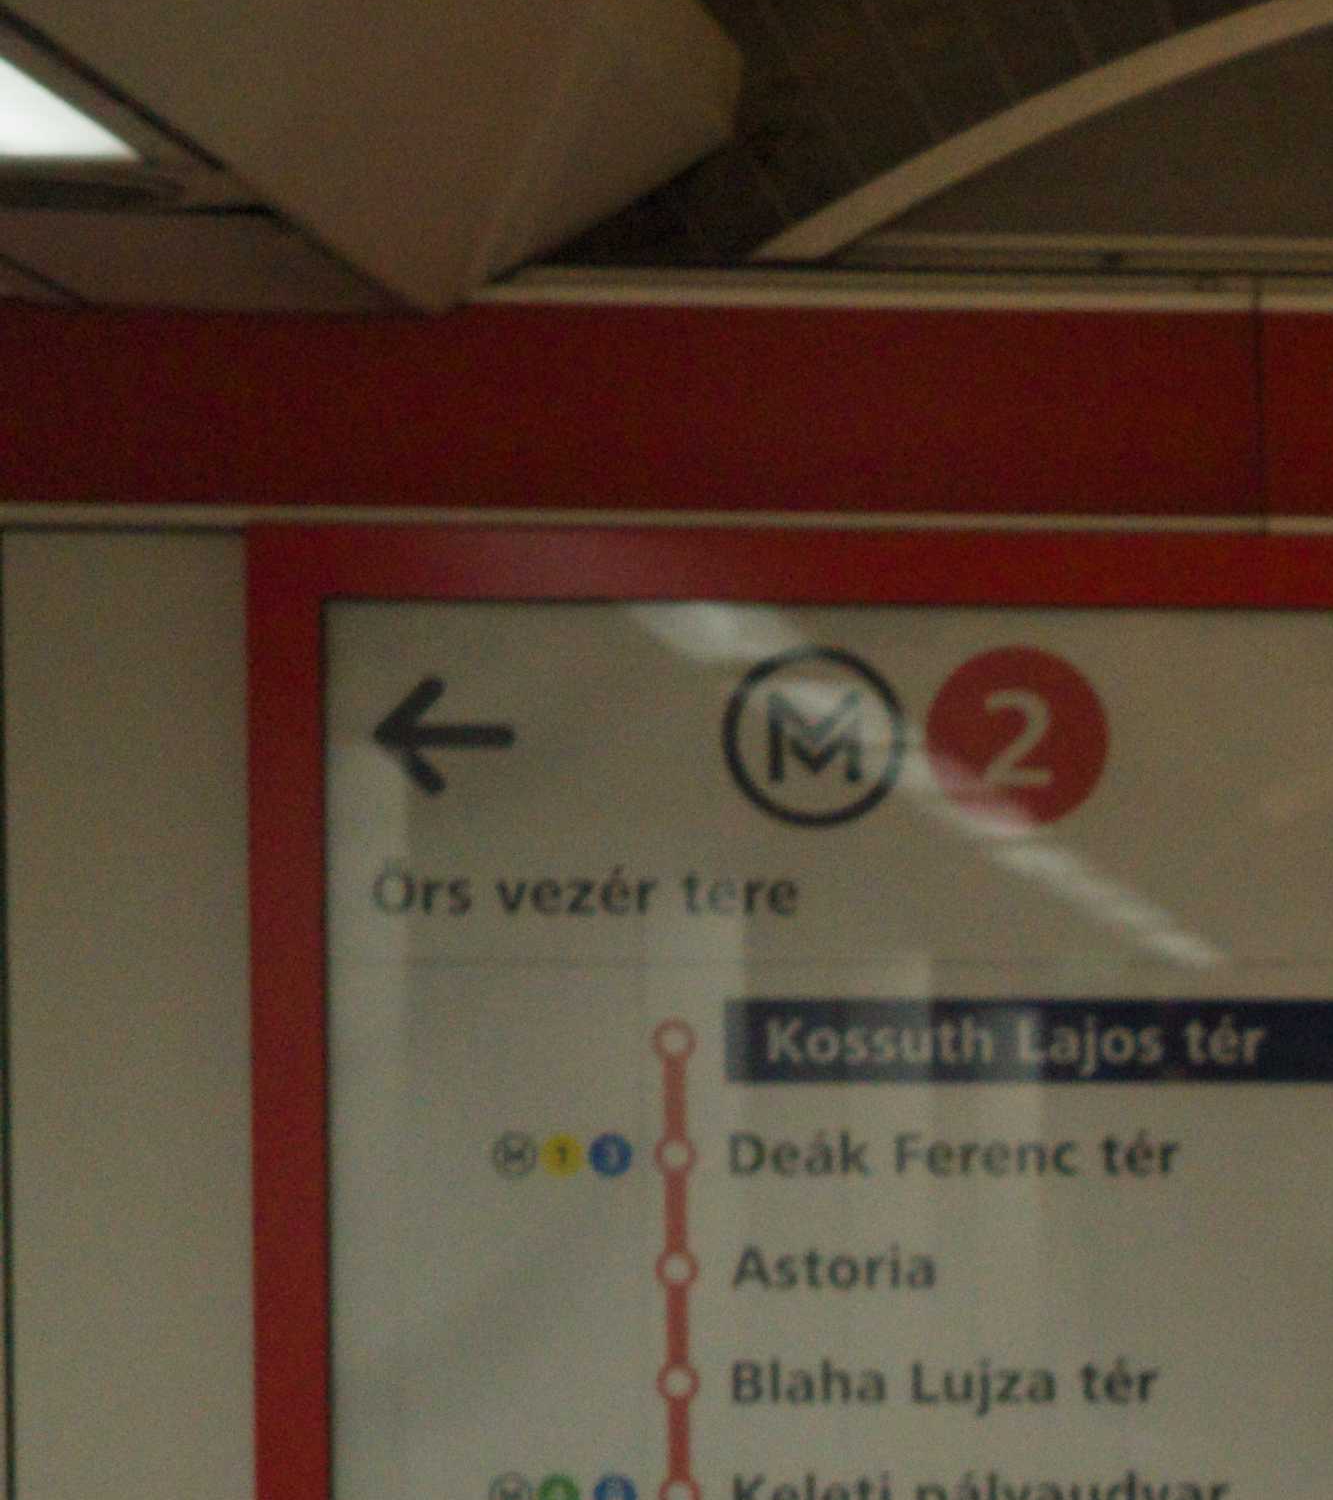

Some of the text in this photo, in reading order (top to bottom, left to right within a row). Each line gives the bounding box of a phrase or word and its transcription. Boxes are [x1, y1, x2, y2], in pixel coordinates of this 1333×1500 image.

[982, 687, 1055, 789] 2
[496, 864, 658, 917] vezér
[683, 870, 800, 916] tere
[767, 1017, 1267, 1077] Kossuth Lajos tér
[728, 1129, 1180, 1178] Deák Ferenc tér
[732, 1245, 937, 1291] Astoria
[731, 1357, 1159, 1418] Blaha Lujza tér
